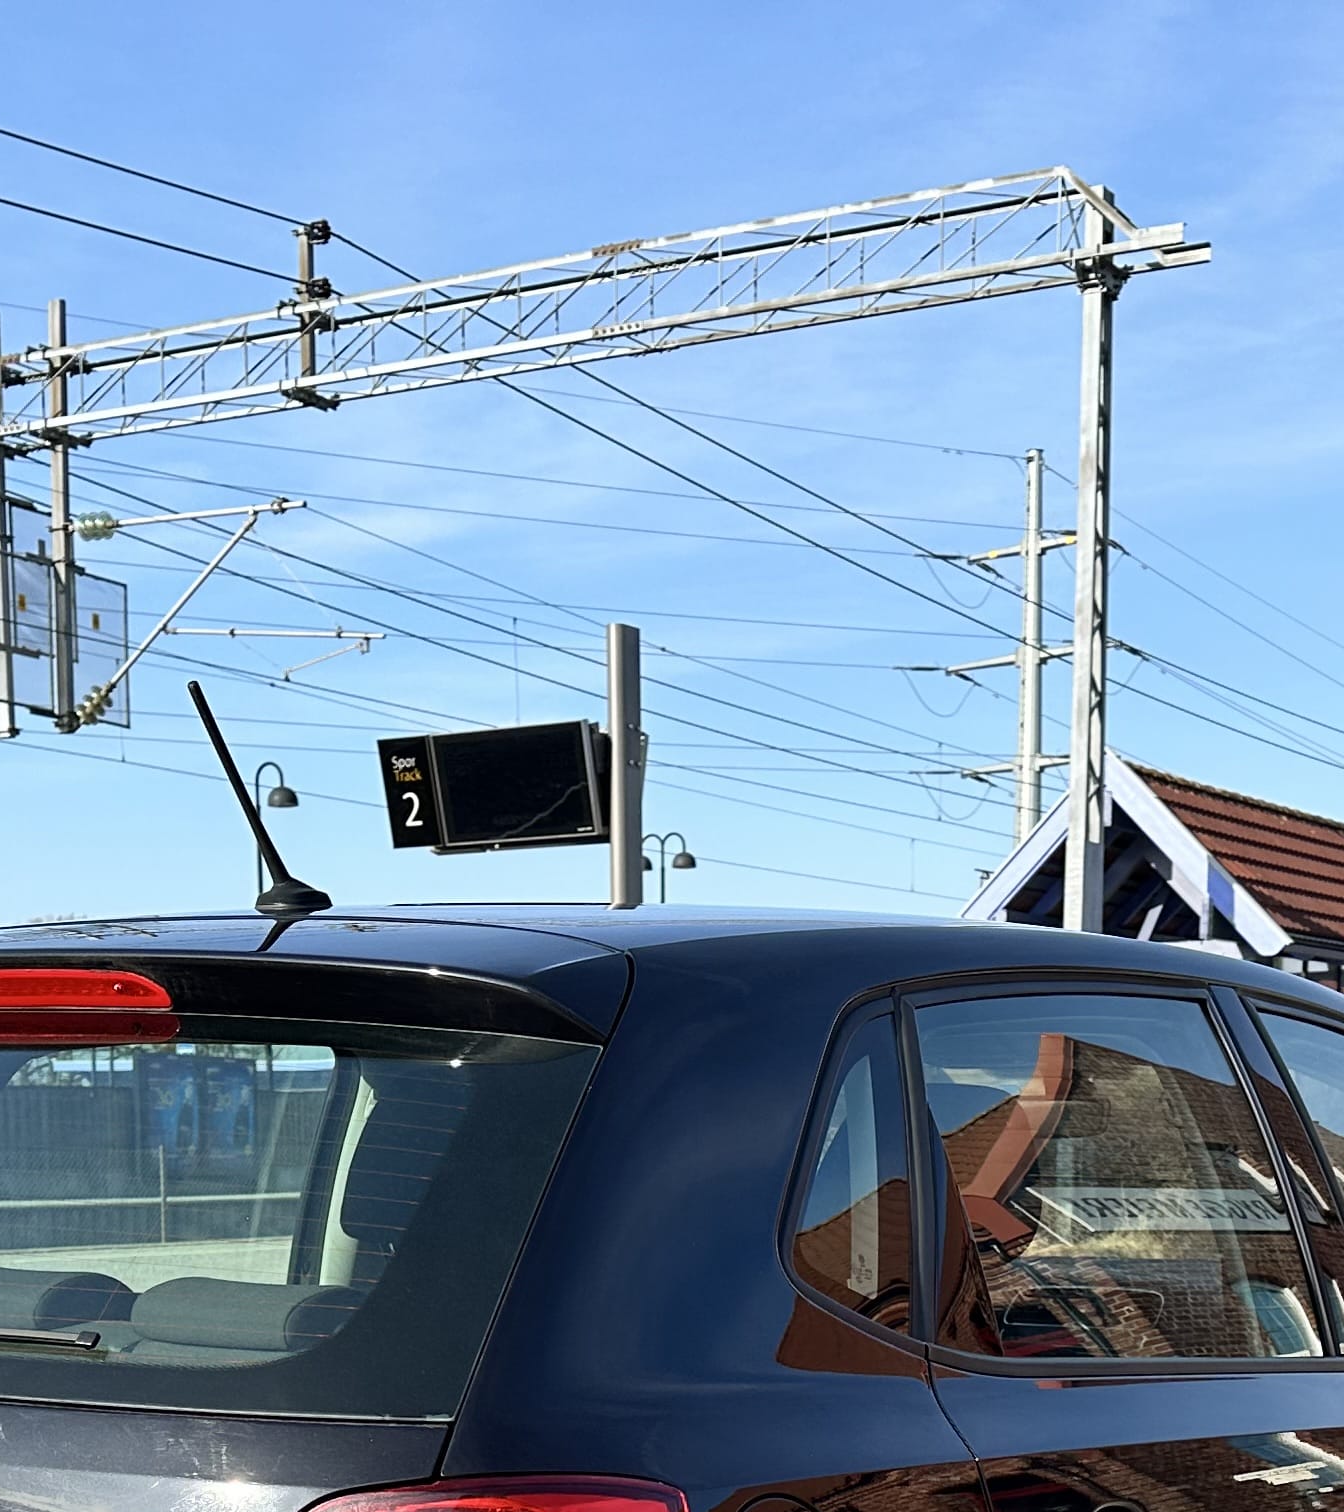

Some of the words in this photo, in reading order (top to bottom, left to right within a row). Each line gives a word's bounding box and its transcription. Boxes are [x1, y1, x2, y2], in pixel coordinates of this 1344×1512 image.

[391, 755, 416, 769] Spor
[393, 769, 424, 782] Track
[402, 791, 424, 827] 2
